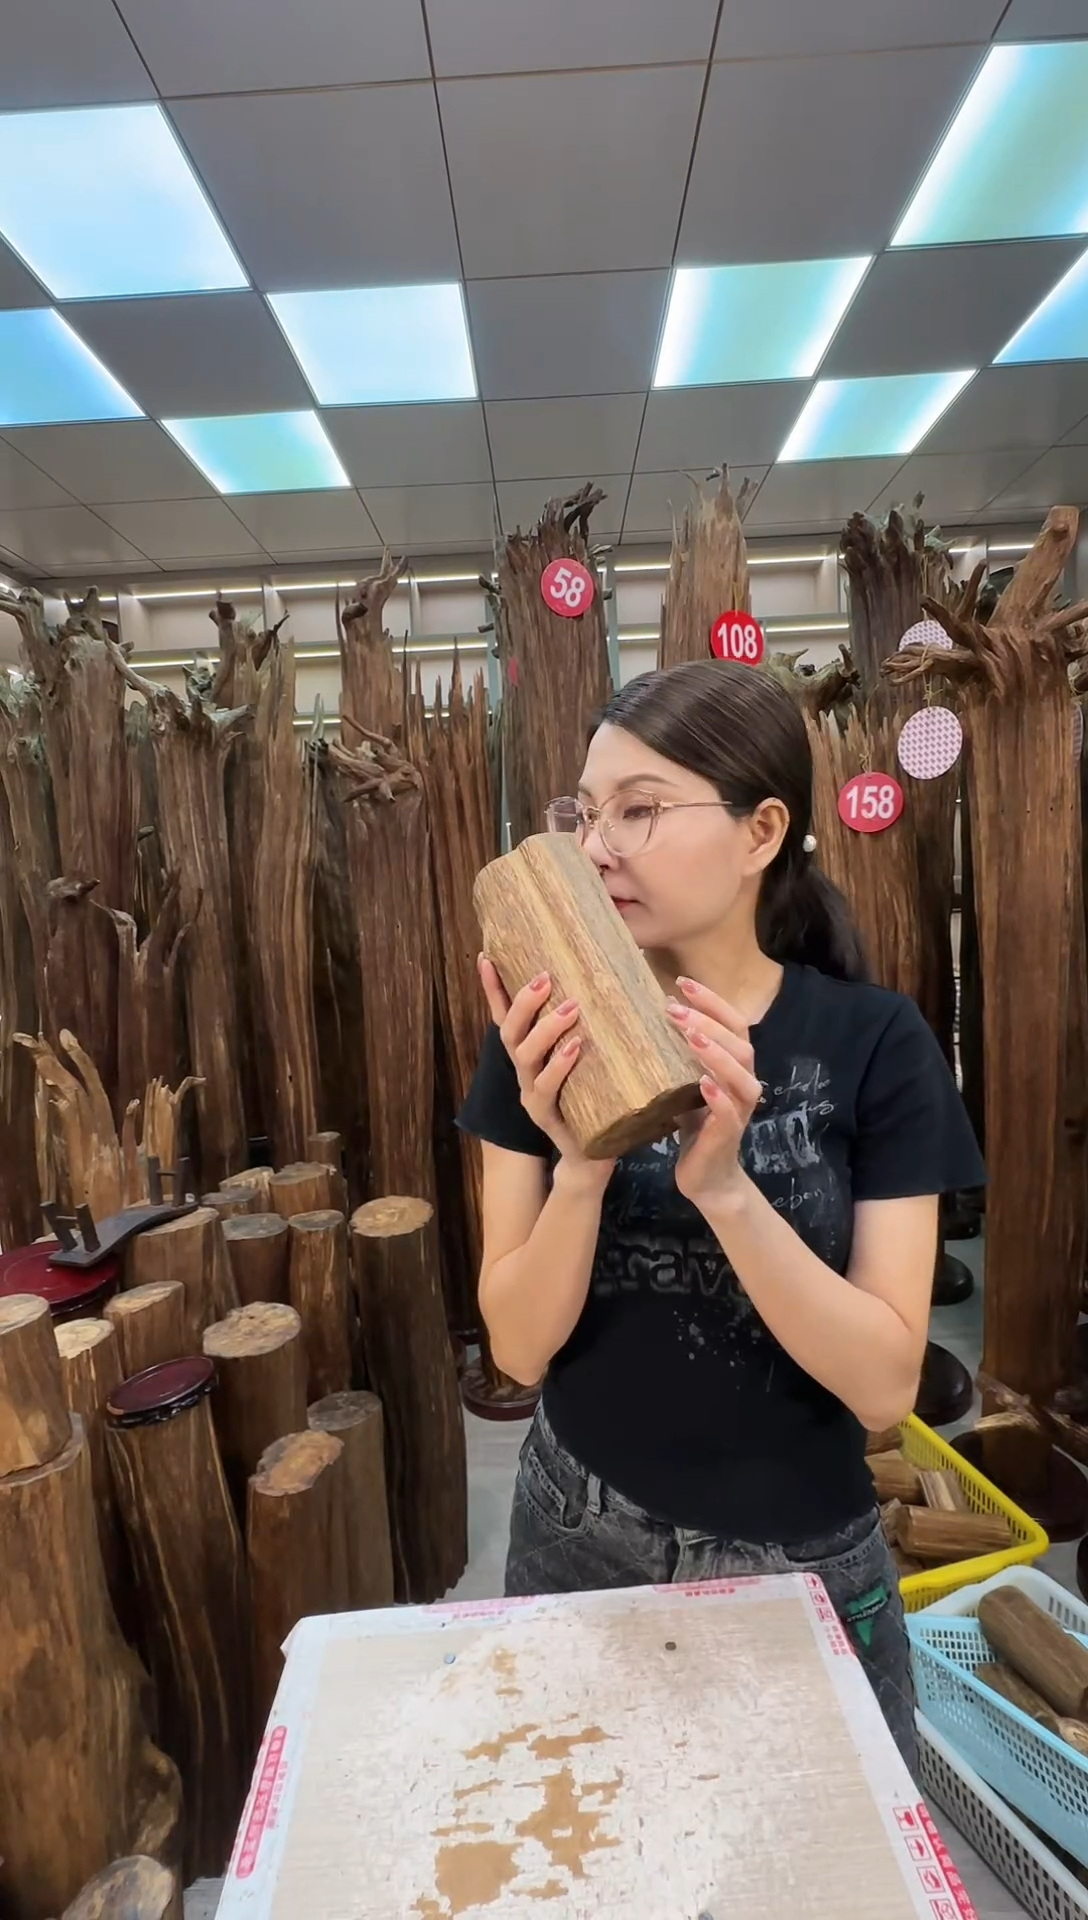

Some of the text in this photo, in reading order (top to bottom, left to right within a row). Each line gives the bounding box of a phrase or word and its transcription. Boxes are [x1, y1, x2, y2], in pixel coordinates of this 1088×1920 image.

[550, 567, 585, 608] 58
[717, 623, 758, 659] 108
[846, 785, 895, 819] 158
